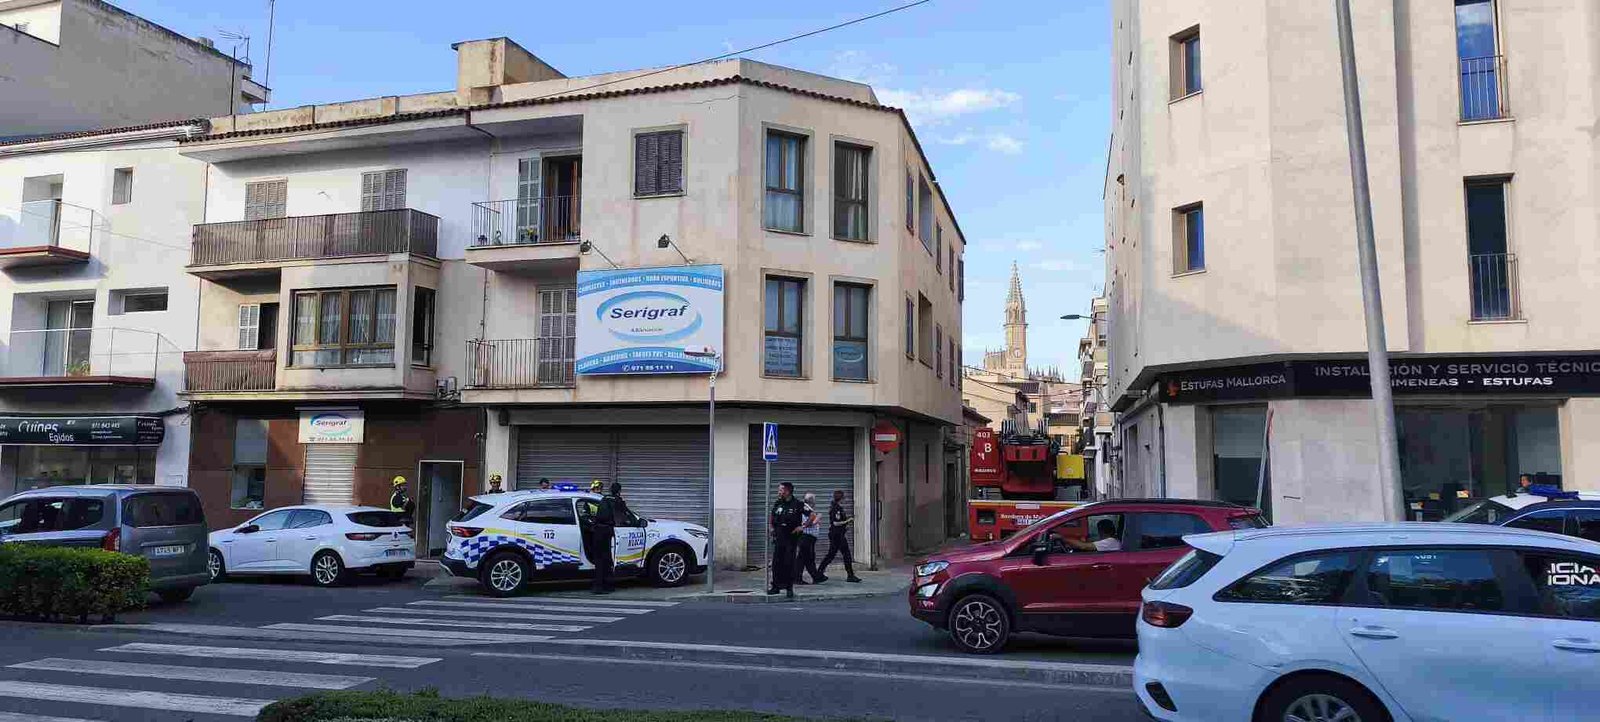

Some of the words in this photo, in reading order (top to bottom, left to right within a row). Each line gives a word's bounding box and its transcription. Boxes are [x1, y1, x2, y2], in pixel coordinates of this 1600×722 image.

[611, 305, 687, 320] Serigraf
[1428, 365, 1440, 375] Y
[1447, 363, 1529, 375] SERVICIO
[1181, 379, 1224, 391] ESTUFAS
[1226, 374, 1286, 388] MALLORCA
[1482, 377, 1554, 386] ESTUFAS
[48, 432, 75, 443] Egidos
[984, 442, 992, 453] B
[543, 532, 555, 540] 112
